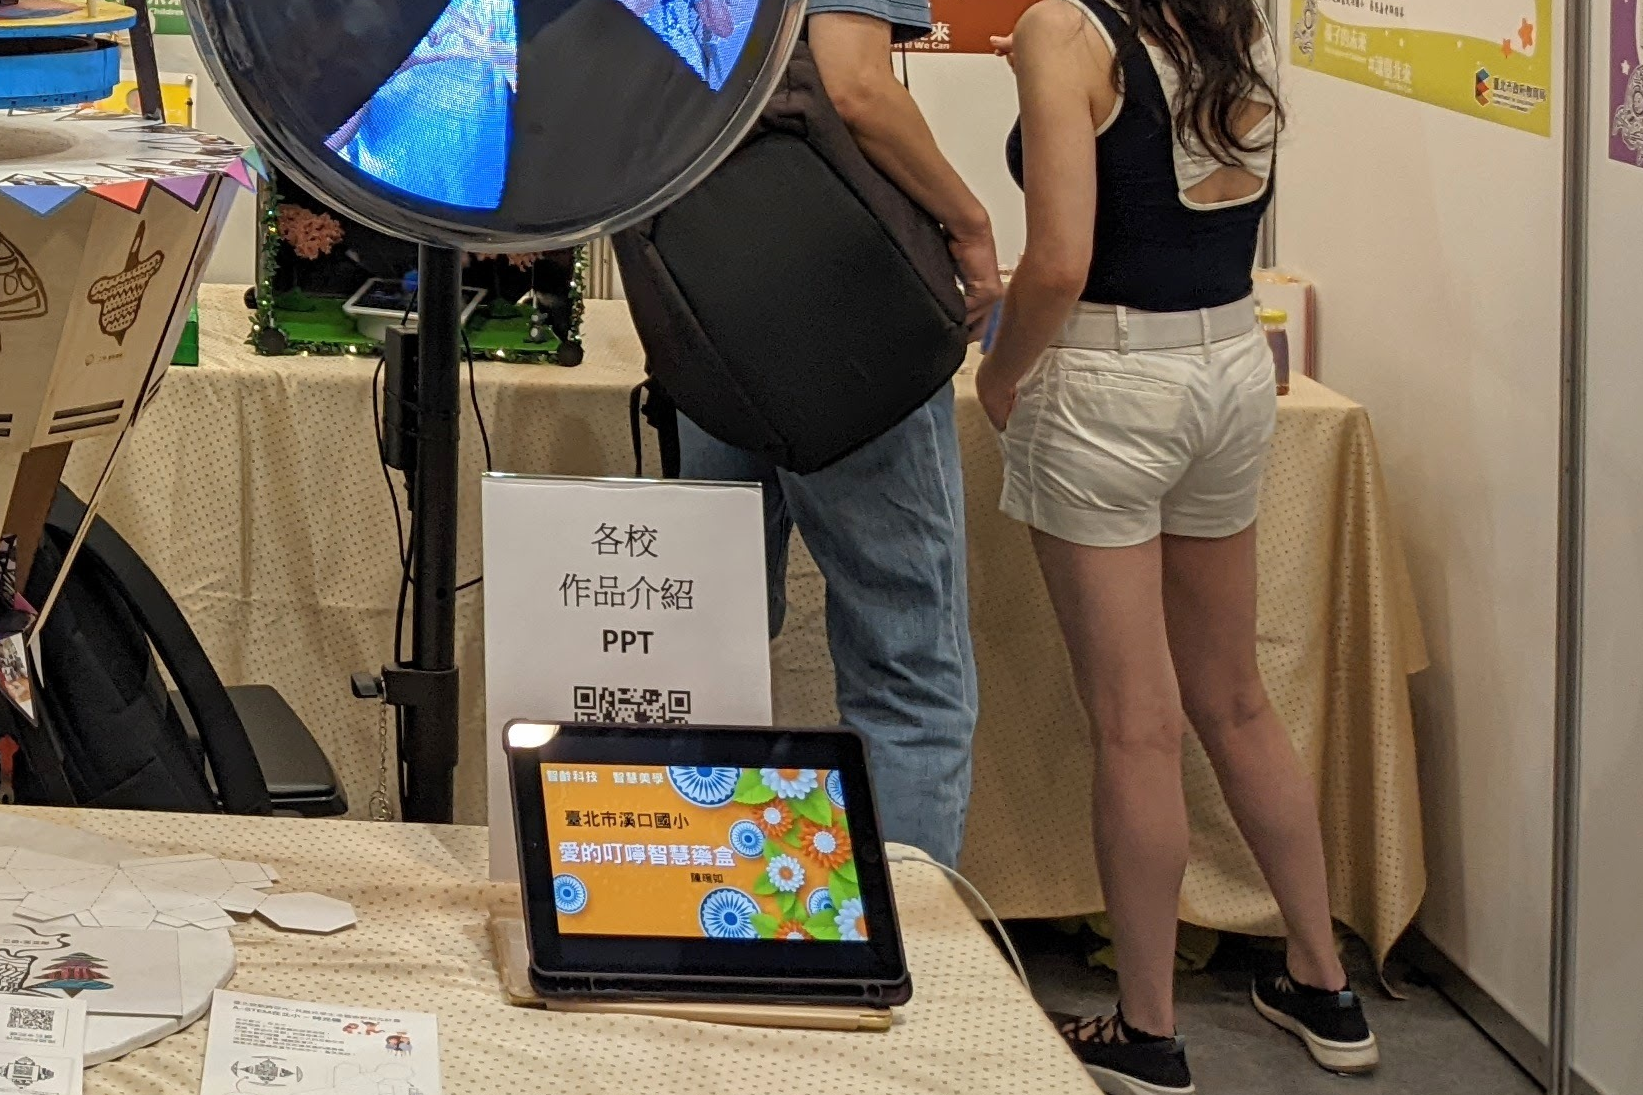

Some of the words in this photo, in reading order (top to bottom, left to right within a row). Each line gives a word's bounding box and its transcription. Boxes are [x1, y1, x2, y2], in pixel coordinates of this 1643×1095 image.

[591, 522, 659, 557] 各校
[559, 573, 694, 610] 作品介紹
[602, 629, 654, 654] PPT
[565, 810, 690, 830] 臺北市溪口國小
[559, 841, 737, 867] 愛的叮嚀智慧藥盒
